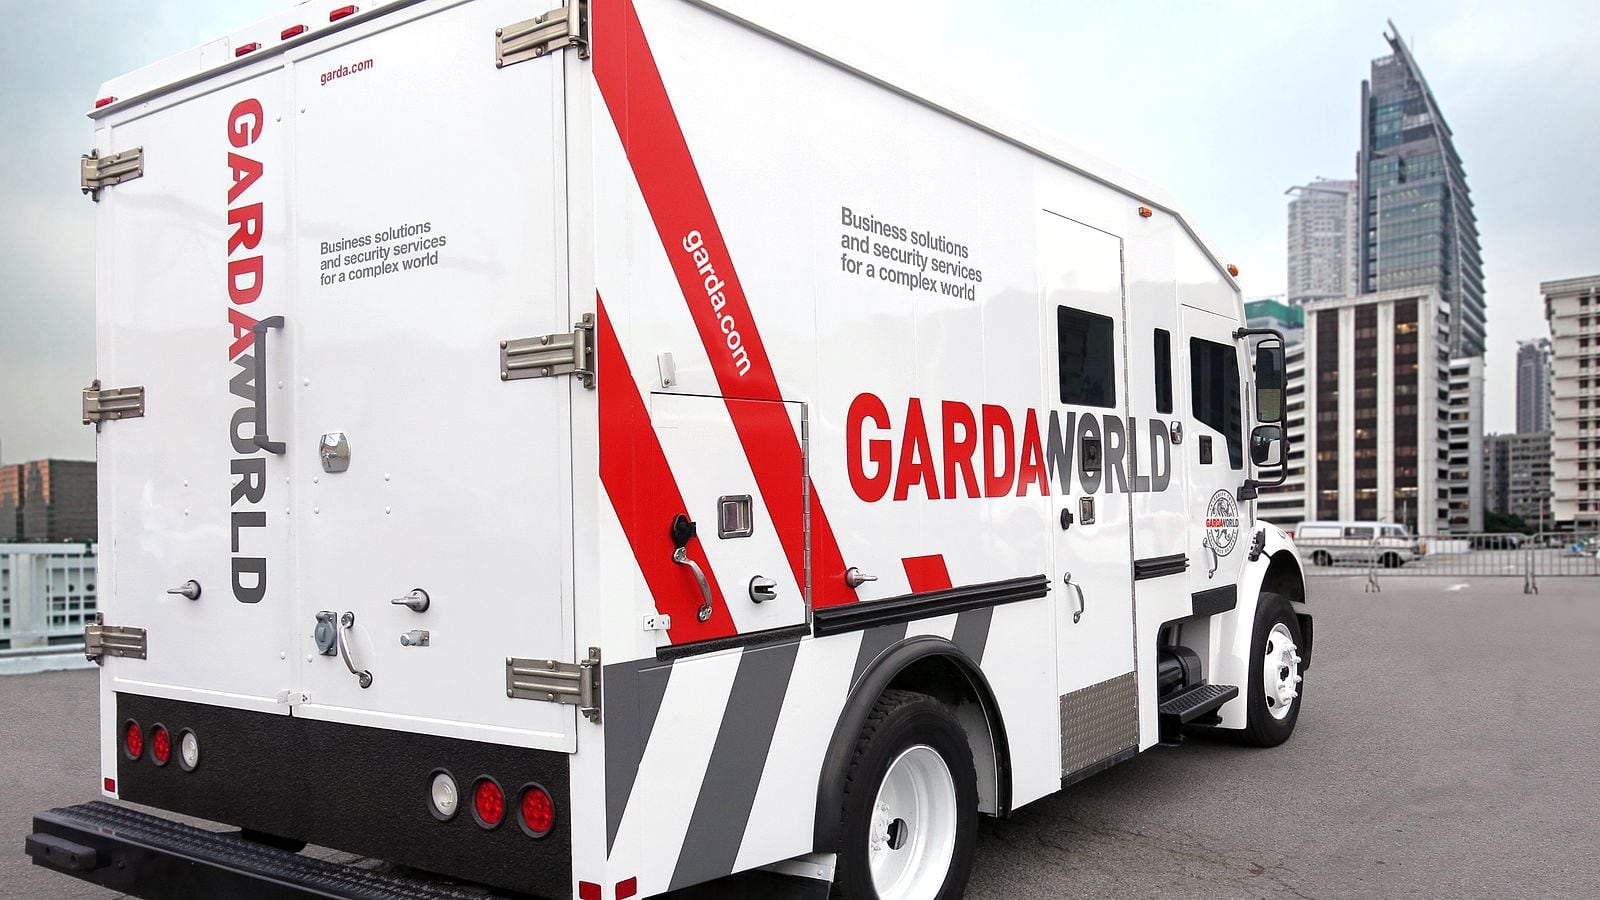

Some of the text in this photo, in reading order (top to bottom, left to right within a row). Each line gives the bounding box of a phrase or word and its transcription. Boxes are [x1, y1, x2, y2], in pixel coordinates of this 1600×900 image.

[320, 58, 374, 87] garda.com
[320, 221, 432, 255] Business solutions
[320, 235, 447, 271] and security services
[841, 206, 969, 259] Business solutions
[320, 250, 439, 286] for a complex world
[840, 253, 976, 302] for a complex world
[841, 233, 983, 283] and security services
[682, 229, 751, 377] garda.com
[227, 97, 267, 604] GARDAWORLD
[845, 391, 1172, 503] GARDAWORLD
[1205, 518, 1240, 528] GARDAWORLD
